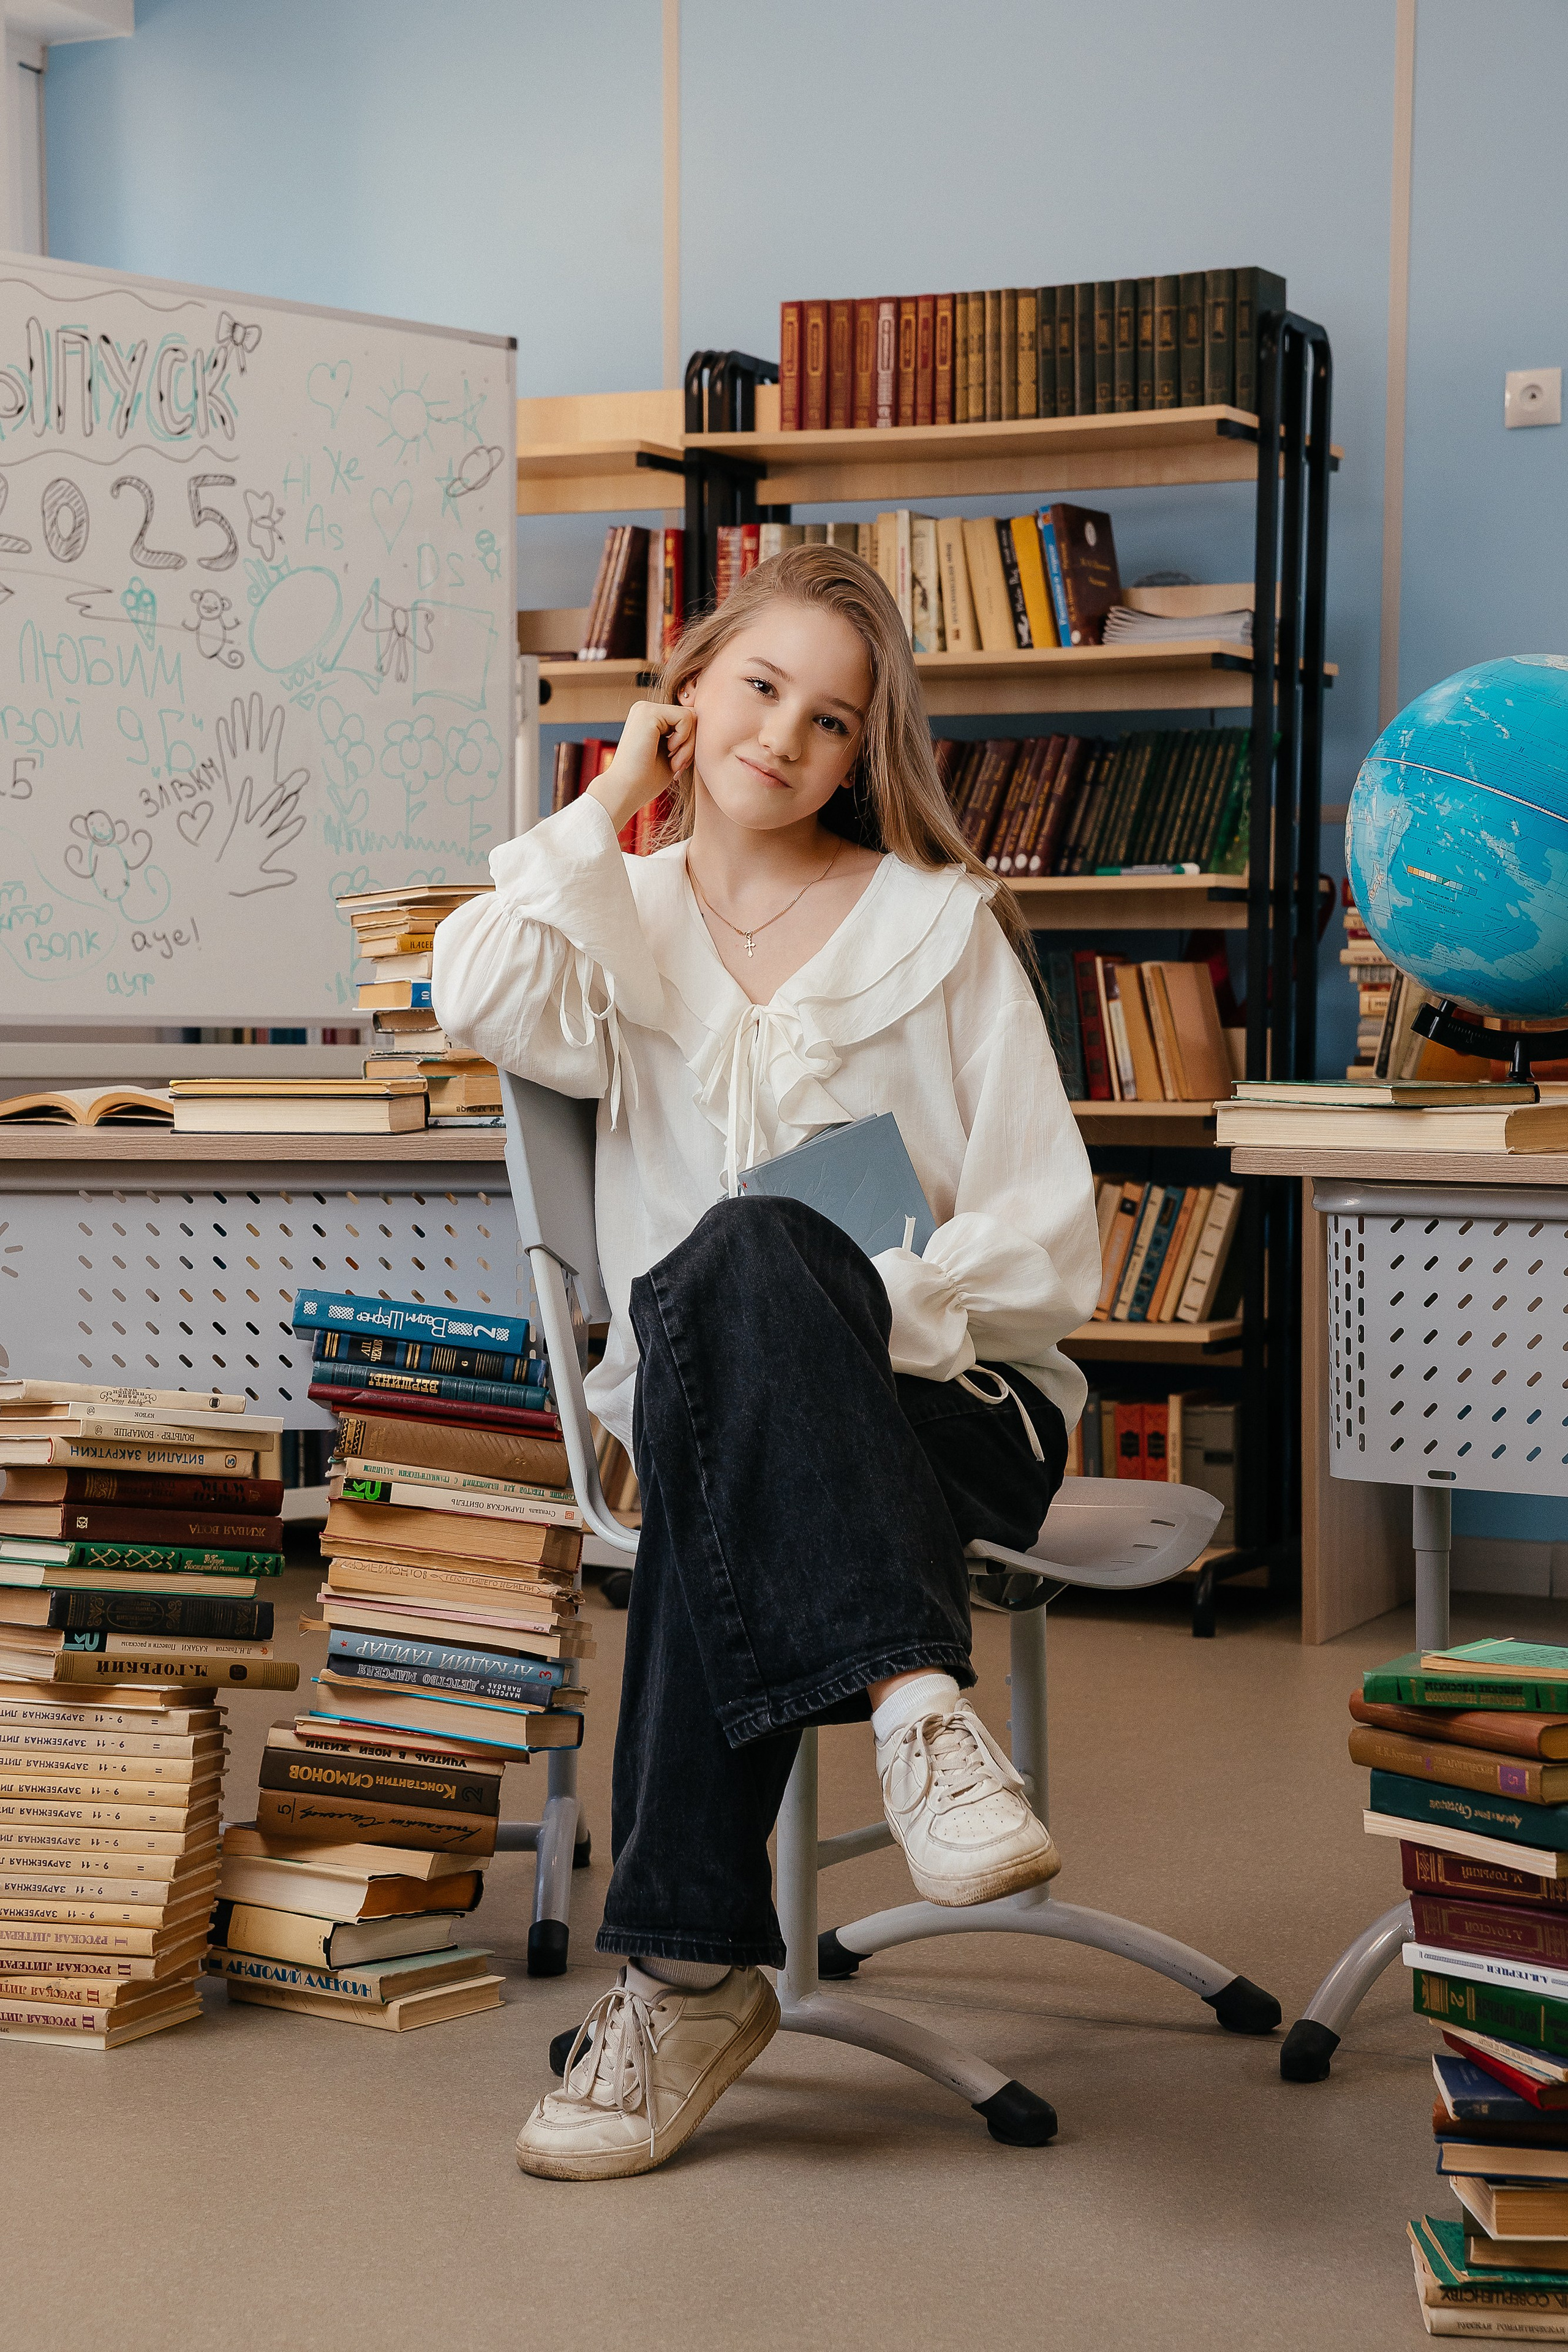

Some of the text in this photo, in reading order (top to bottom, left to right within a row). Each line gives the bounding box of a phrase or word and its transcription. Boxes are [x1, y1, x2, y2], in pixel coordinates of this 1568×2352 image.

[356, 1306, 497, 1339] 2 Вадим Шефнер
[371, 1339, 383, 1362] ЧЕХОВ
[369, 1372, 440, 1393] ВЕРШИНЫ
[113, 1428, 195, 1442] ВОЛЬТЕР БОМАРШЕ
[70, 1445, 142, 1461] ЗАКРУТКИН
[146, 1450, 205, 1466] ВИТАЛИЙ
[398, 1469, 450, 1484] ГРАММАТИЧЕСКИМ
[462, 1478, 499, 1491] ИЗЛОЖЕНИЙ
[503, 1484, 516, 1493] ДЛЯ
[549, 1491, 576, 1501] СБОРНИК
[451, 1498, 556, 1518] Стендаль ПАРМСКАЯ ОБИТЕЛЬ
[187, 1523, 266, 1537] ЖИВАЯ ВОДА
[121, 1640, 148, 1649] рассказы
[153, 1642, 176, 1652] Повести
[181, 1643, 208, 1653] КАЗАКИ
[355, 1639, 552, 1681] 3 АРКАДИЙ ГАЙДАР
[357, 1664, 480, 1692] ДЕТСТВО МАРСЕЛЯ
[487, 1683, 521, 1693] ПАНЬОЛЬ
[487, 1689, 521, 1699] МАРСЕЛЬ
[22, 1711, 85, 1722] ЗАРУБЕЖНАЯ
[24, 1736, 87, 1747] ЗАРУБЕЖНАЯ
[304, 1740, 468, 1769] УЧИТЕЛЬ В МОЕЙ ЖИЗНИ
[26, 1760, 89, 1771] ЗАРУБЕЖНАЯ
[18, 1784, 81, 1795] ЗАРУБЕЖНАЯ
[288, 1764, 483, 1804] 2 Константин СИМОНОВ
[20, 1807, 83, 1819] ЗАРУБЕЖНАЯ
[277, 1803, 292, 1815] 5
[18, 1834, 81, 1845] ЗАРУБЕЖНАЯ
[9, 1858, 72, 1868] ЗАРУБЕЖНАЯ
[1461, 1866, 1508, 1882] ГОРЬКИЙ
[4, 1882, 66, 1893] ЗАРУБЕЖНАЯ
[54, 1933, 108, 1945] РУССКАЯ
[56, 1962, 111, 1975] РУССКАЯ
[225, 1959, 373, 1999] АНАТОЛИЙ АЛЕКСИН
[31, 1986, 82, 2001] РУССКАЯ
[27, 2013, 77, 2027] РУССКАЯ
